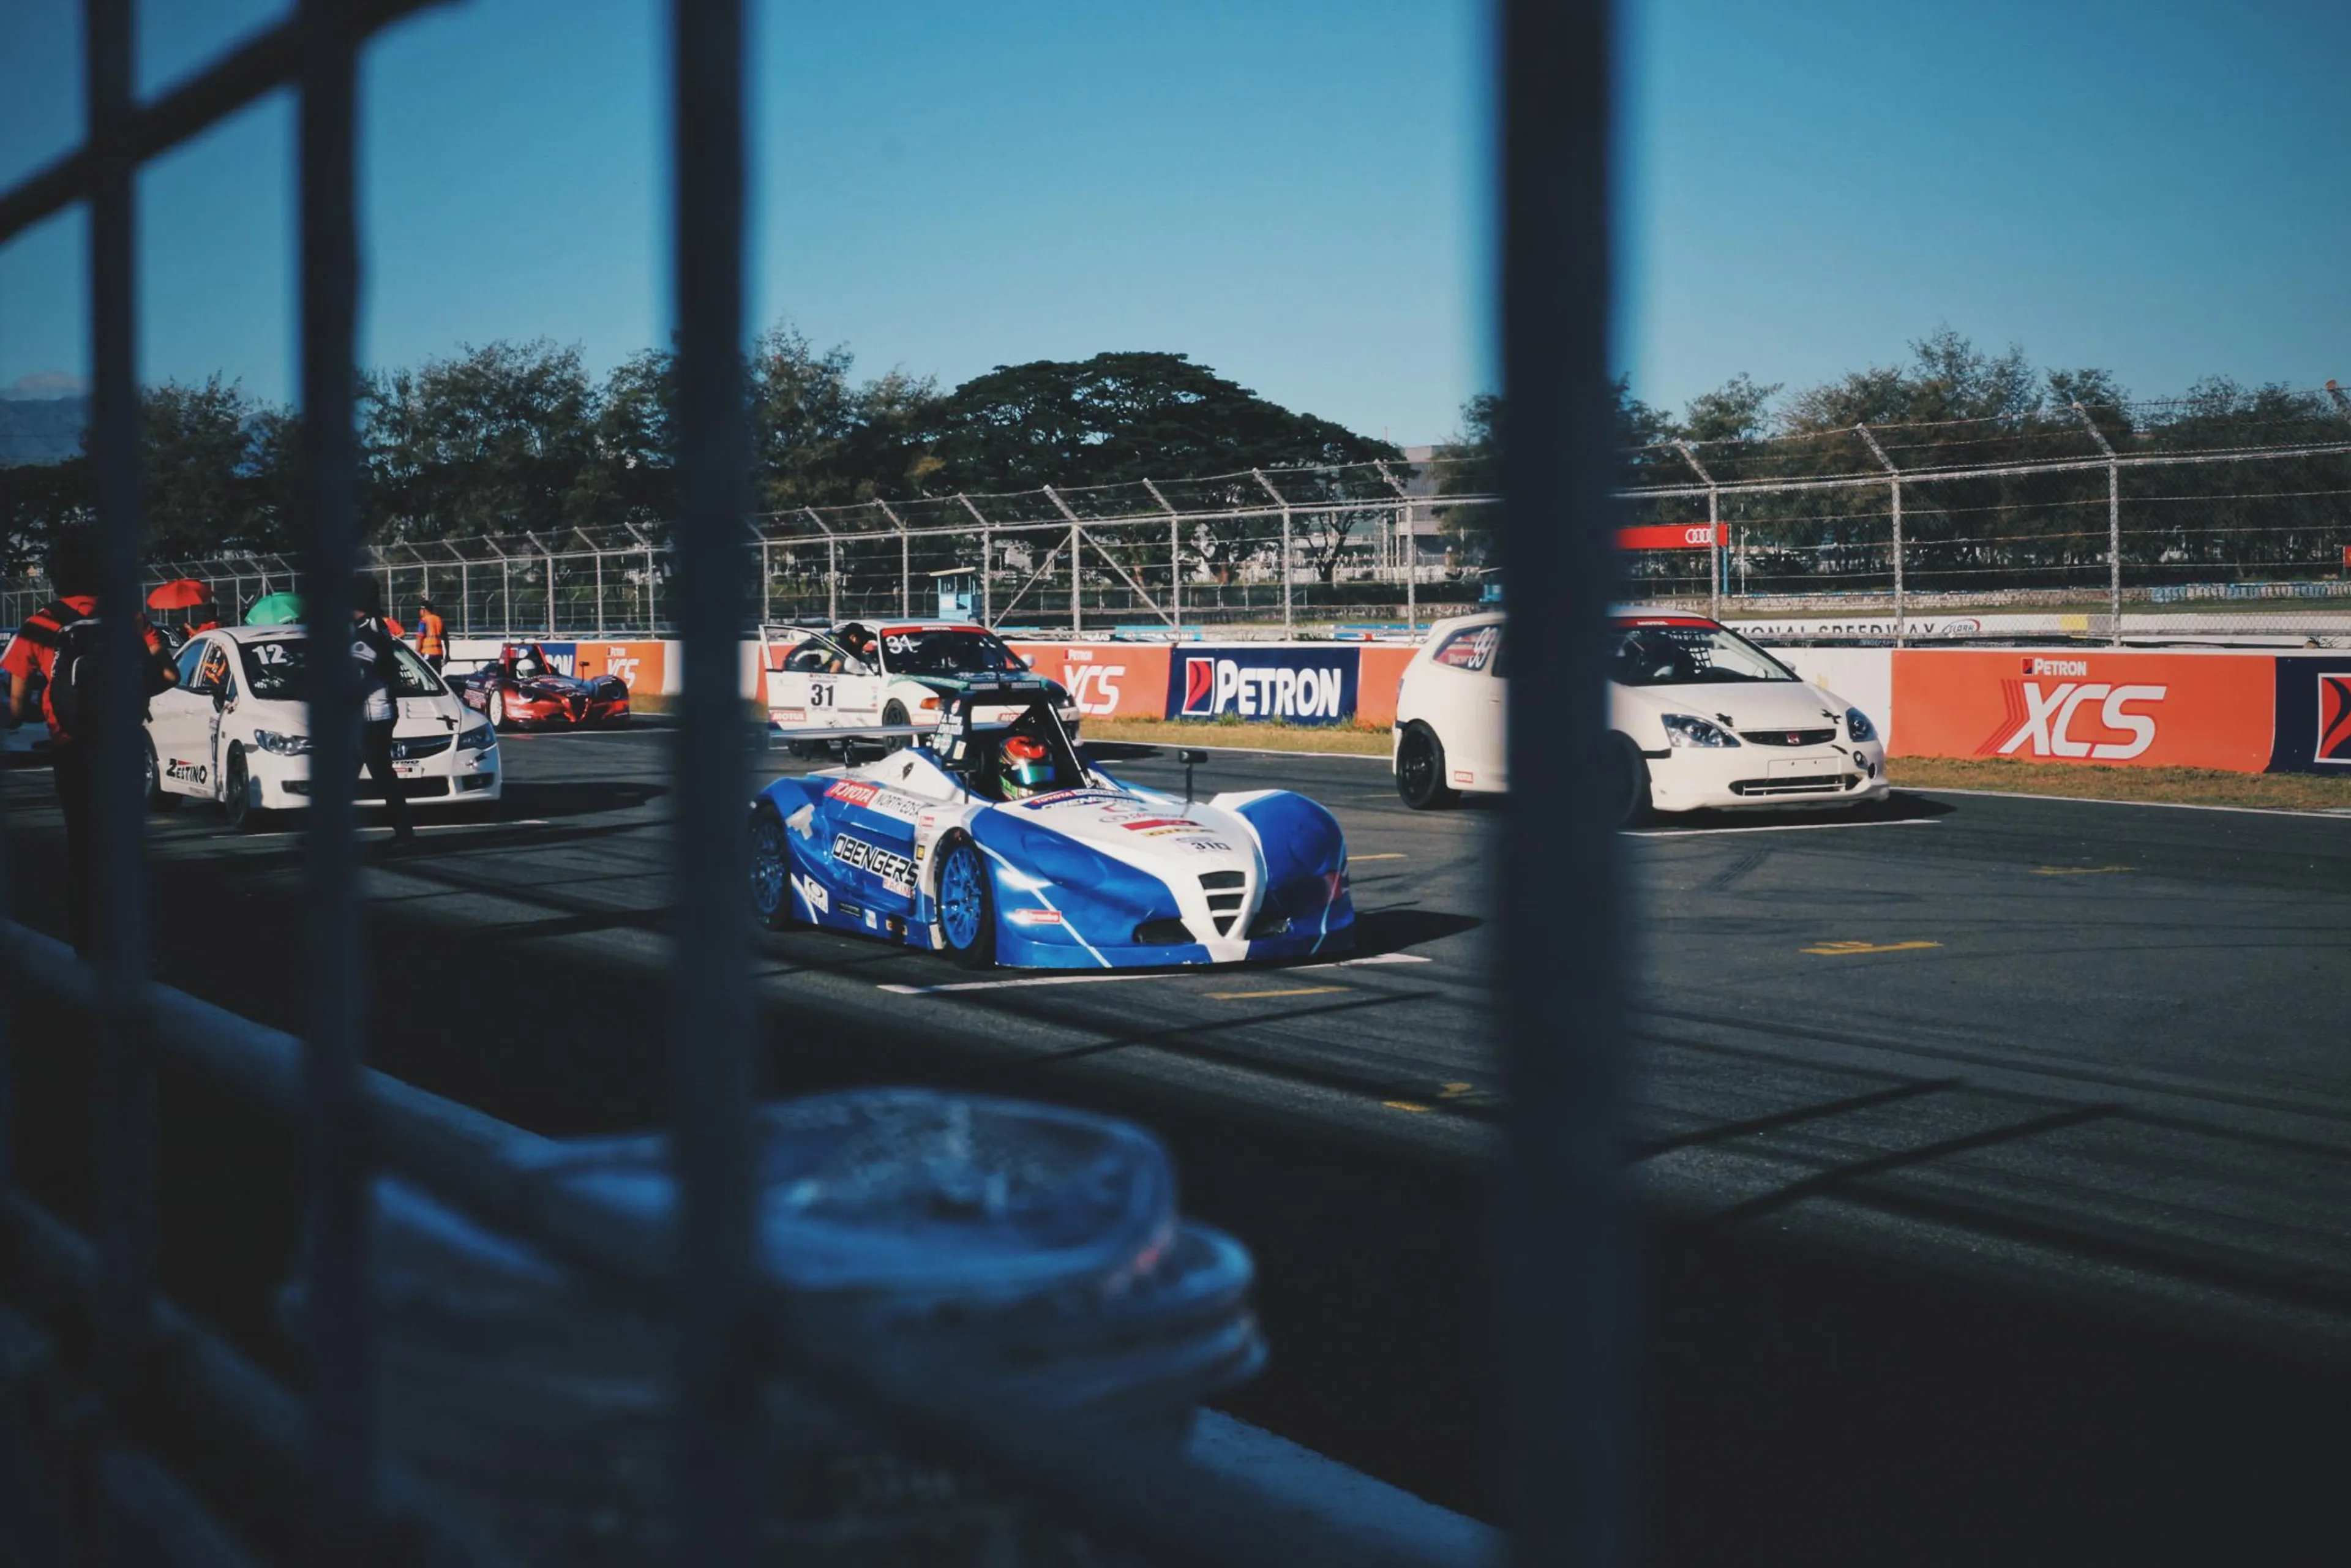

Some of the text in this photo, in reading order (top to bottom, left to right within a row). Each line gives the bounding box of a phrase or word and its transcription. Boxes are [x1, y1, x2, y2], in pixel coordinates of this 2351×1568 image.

[252, 644, 287, 665] 12
[2034, 658, 2087, 677] PETRON
[811, 684, 834, 706] 31
[1214, 659, 1341, 717] PETRON
[773, 712, 806, 721] MOTUL
[1998, 682, 2167, 759] XCS
[167, 759, 207, 784] ZESTINO
[831, 781, 875, 803] TOYOTA
[833, 835, 920, 888] OBENGERS
